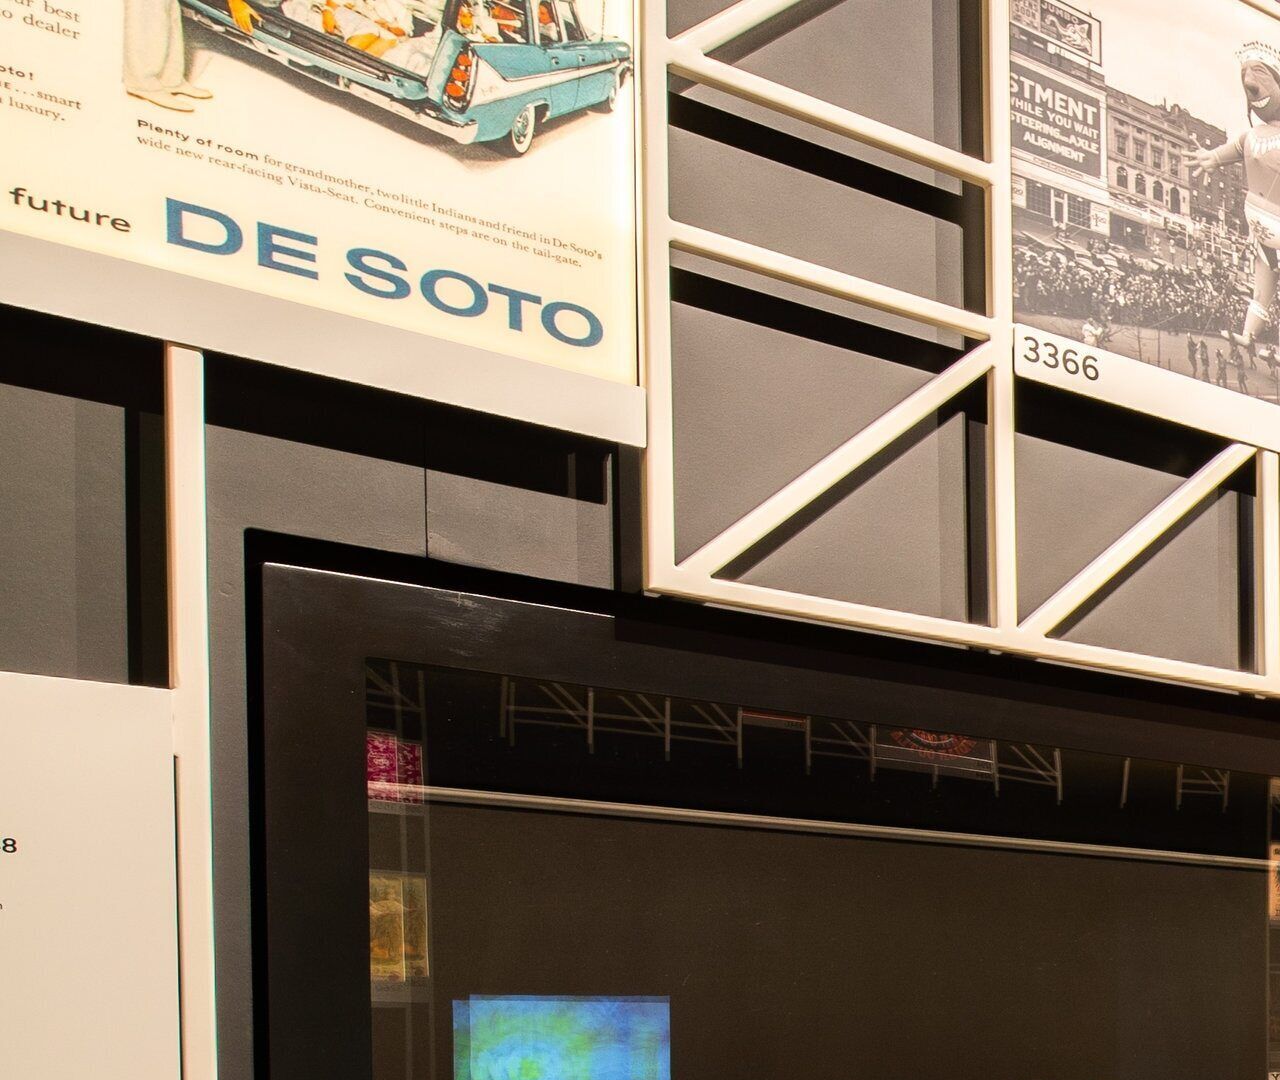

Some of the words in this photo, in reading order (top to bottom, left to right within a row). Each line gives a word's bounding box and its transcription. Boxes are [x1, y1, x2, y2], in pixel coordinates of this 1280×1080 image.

[23, 13, 81, 40] dealer
[44, 1, 81, 23] best
[9, 96, 66, 122] luxury.
[1046, 109, 1072, 130] YOU
[1073, 121, 1100, 141] WAIT
[1023, 131, 1086, 164] ALIGNMENT
[136, 134, 171, 152] wide
[175, 145, 204, 161] new
[208, 156, 284, 185] rear-facing
[364, 197, 436, 227] Convenient
[438, 219, 468, 236] steps
[471, 229, 490, 243] are
[492, 235, 508, 247] on
[511, 238, 529, 254] the
[137, 118, 190, 142] Plenty
[196, 137, 213, 147] of
[217, 143, 259, 161] room
[263, 153, 282, 169] for
[284, 162, 374, 197] grandmother,
[431, 202, 477, 225] Indians
[478, 215, 500, 232] and
[502, 223, 536, 242] friend
[570, 242, 603, 261] Soto's
[9, 187, 132, 234] future
[165, 196, 319, 281] DE
[343, 245, 605, 349] SOTO
[1023, 336, 1099, 381] 3366
